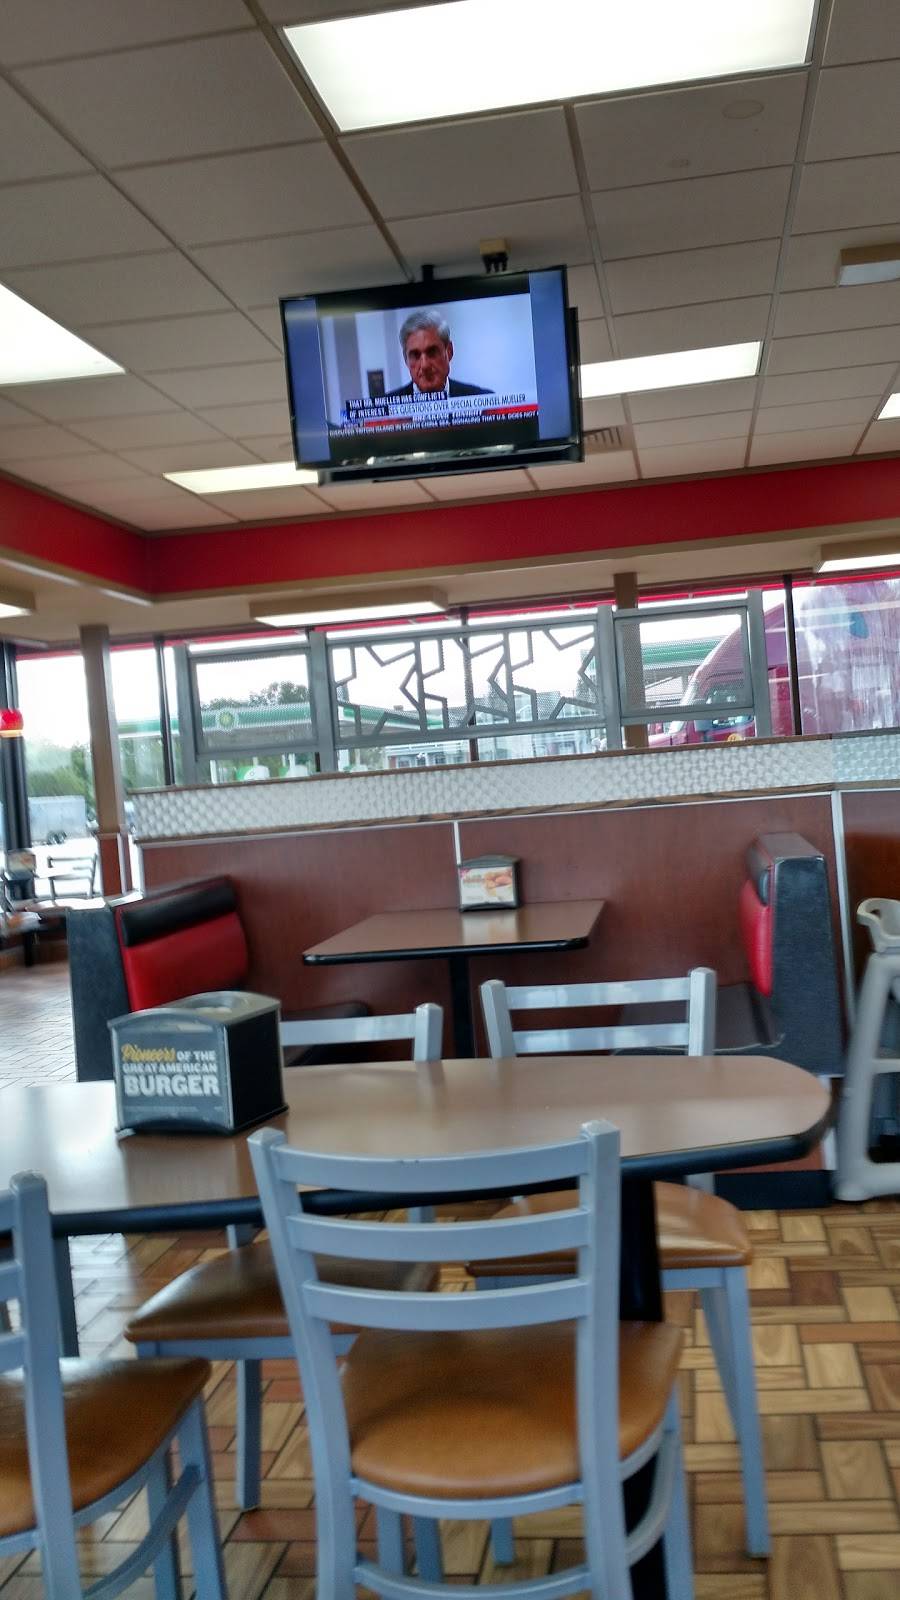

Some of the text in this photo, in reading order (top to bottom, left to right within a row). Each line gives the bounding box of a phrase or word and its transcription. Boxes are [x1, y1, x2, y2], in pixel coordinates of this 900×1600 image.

[375, 395, 400, 406] MUELLER
[401, 401, 433, 414] QUESTIONS
[434, 401, 449, 411] OVER
[450, 398, 472, 409] SPECIAL
[473, 396, 500, 407] COUNSEL
[501, 393, 526, 404] MUELLER
[481, 414, 495, 423] THAT
[177, 1050, 190, 1061] OF
[193, 1050, 216, 1061] THE
[123, 1062, 217, 1074] GREAT AMERICAN
[123, 1074, 220, 1097] BURGER
